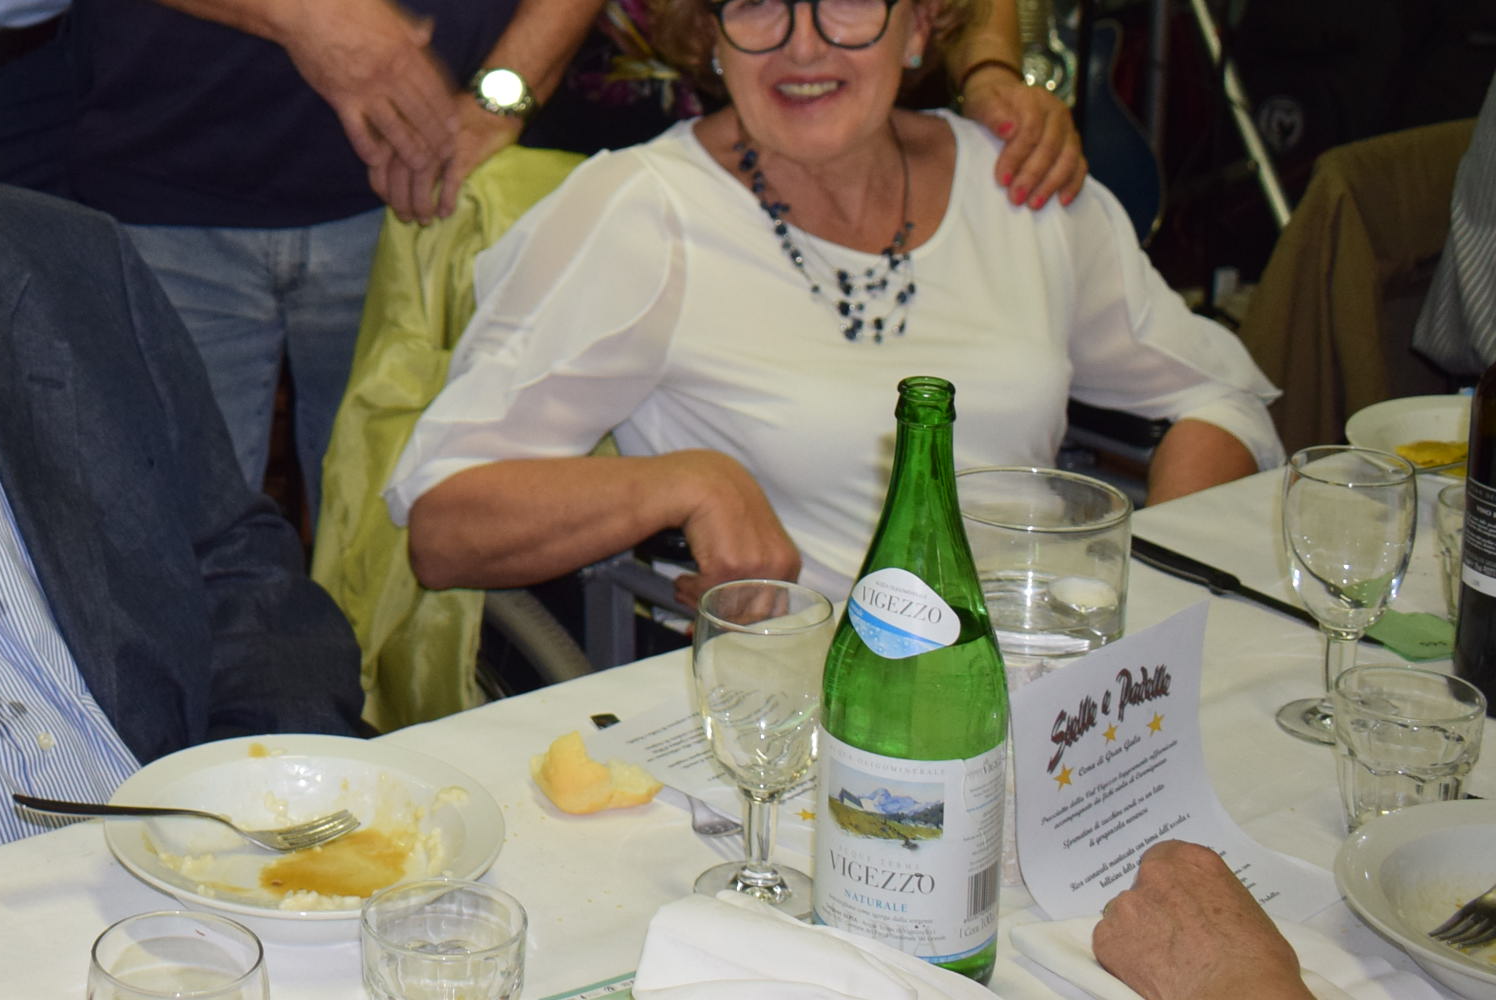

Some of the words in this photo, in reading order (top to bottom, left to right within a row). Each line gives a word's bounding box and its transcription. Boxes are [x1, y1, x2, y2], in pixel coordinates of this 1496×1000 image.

[861, 585, 942, 625] VIGEZZO
[829, 848, 935, 896] VIGEZZO
[844, 888, 909, 913] NATURALE
